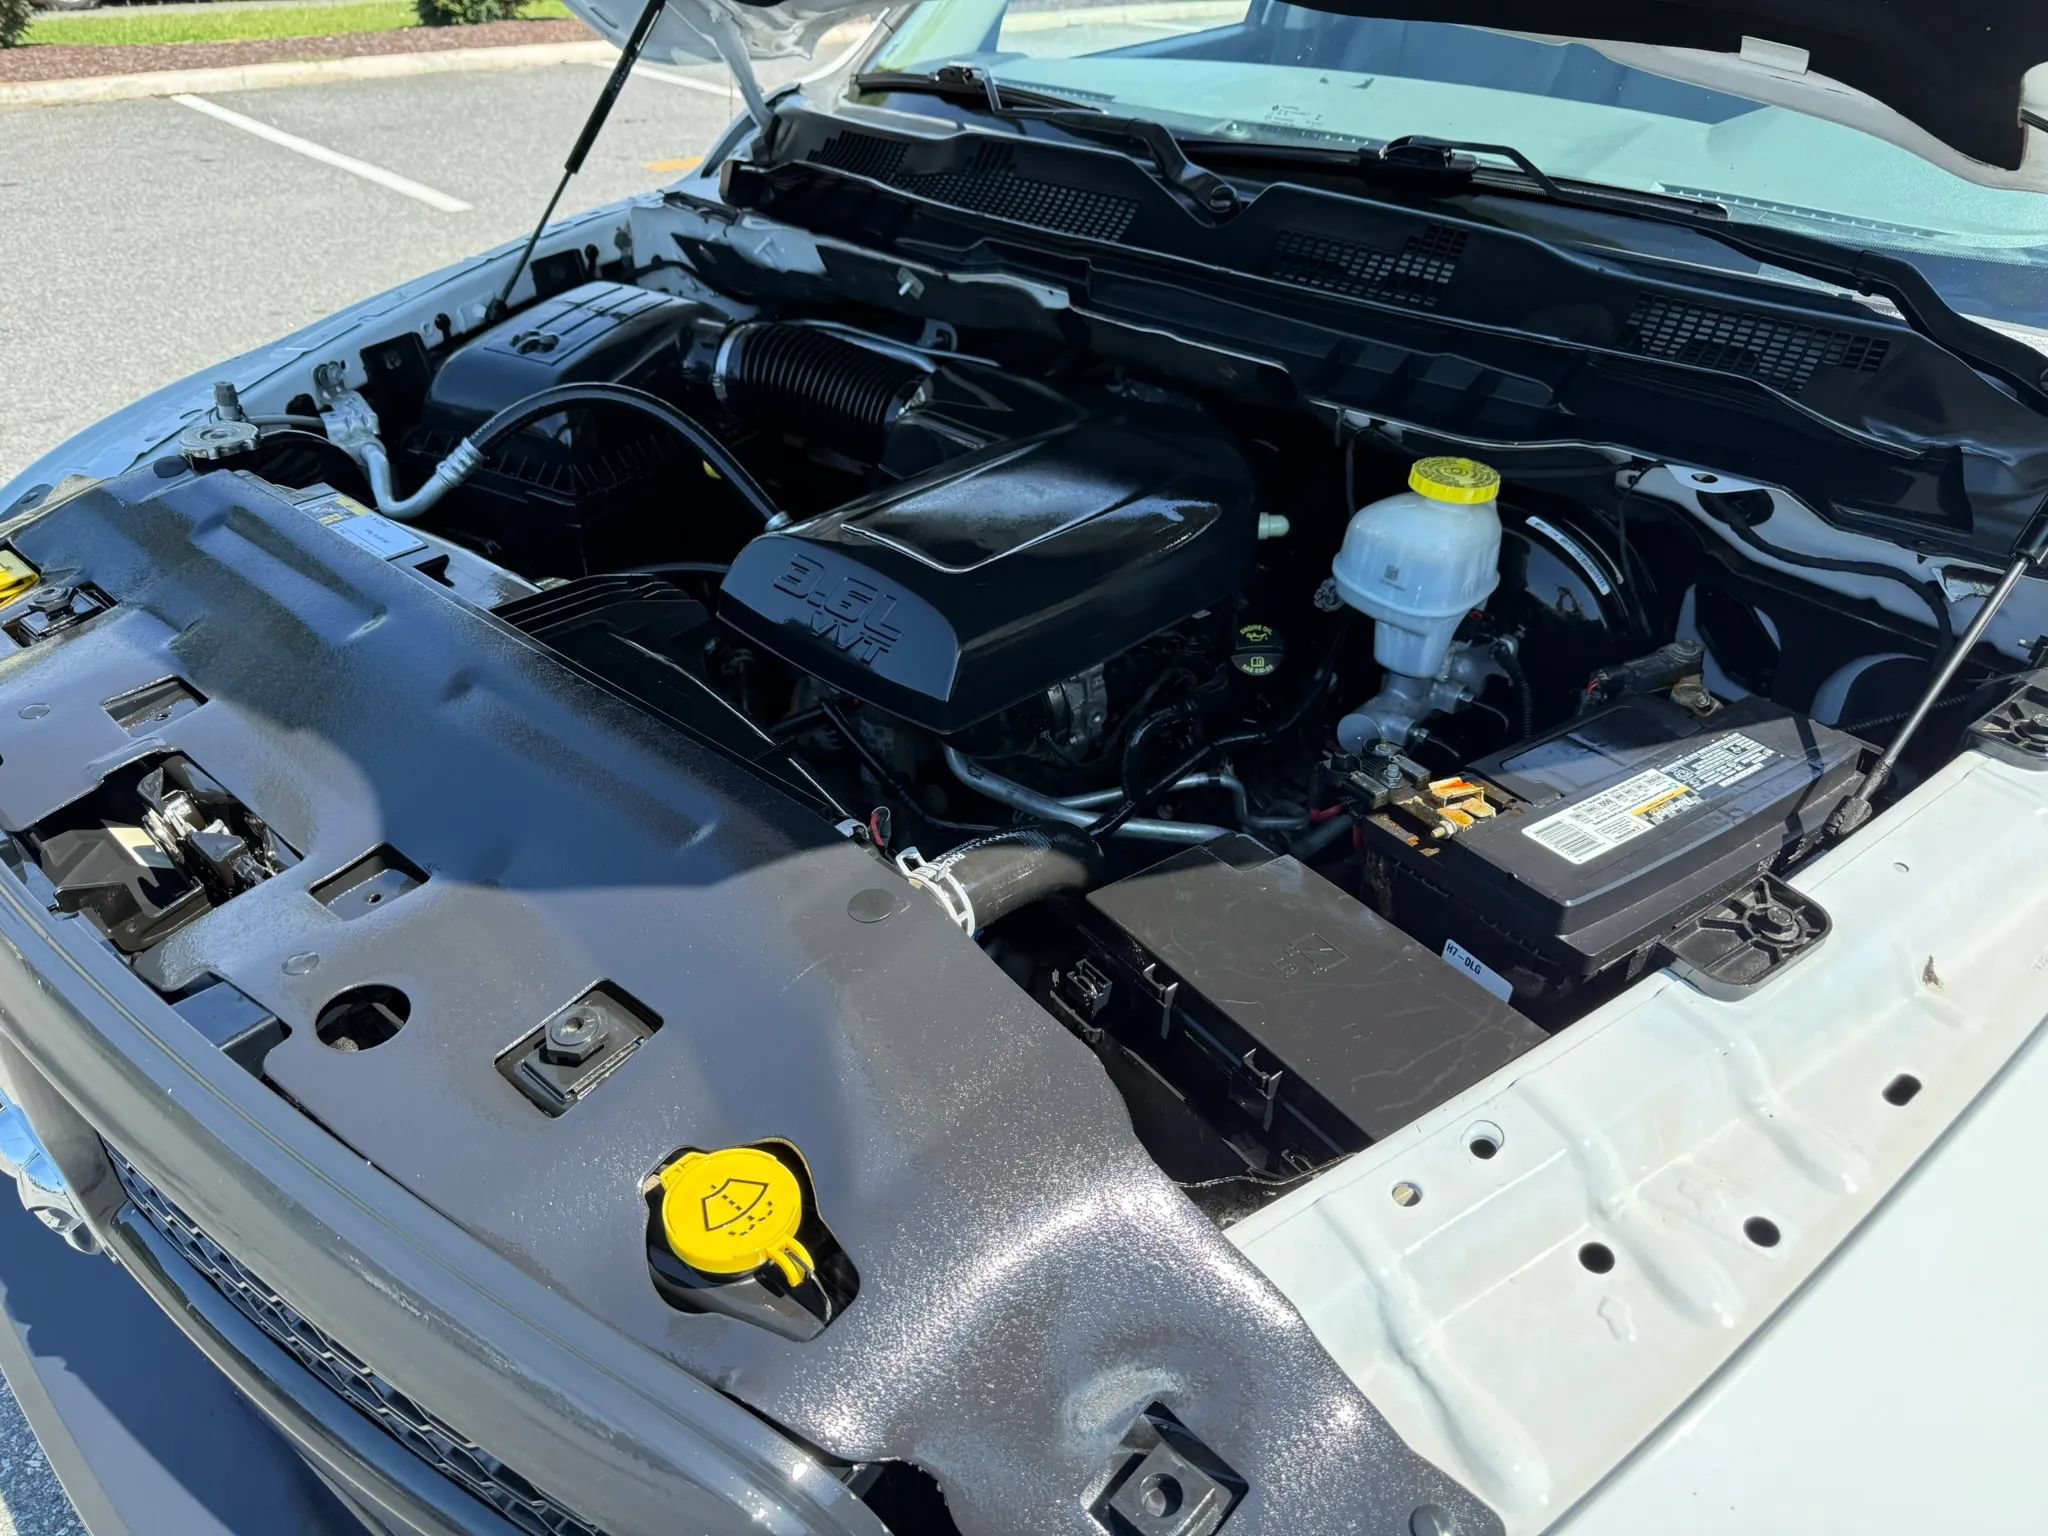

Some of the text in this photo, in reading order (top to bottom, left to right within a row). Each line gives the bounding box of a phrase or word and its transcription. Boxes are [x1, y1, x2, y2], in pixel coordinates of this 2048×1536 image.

[773, 553, 902, 642] 3.6L
[809, 610, 890, 665] VVT
[1240, 624, 1262, 635] ENGINE
